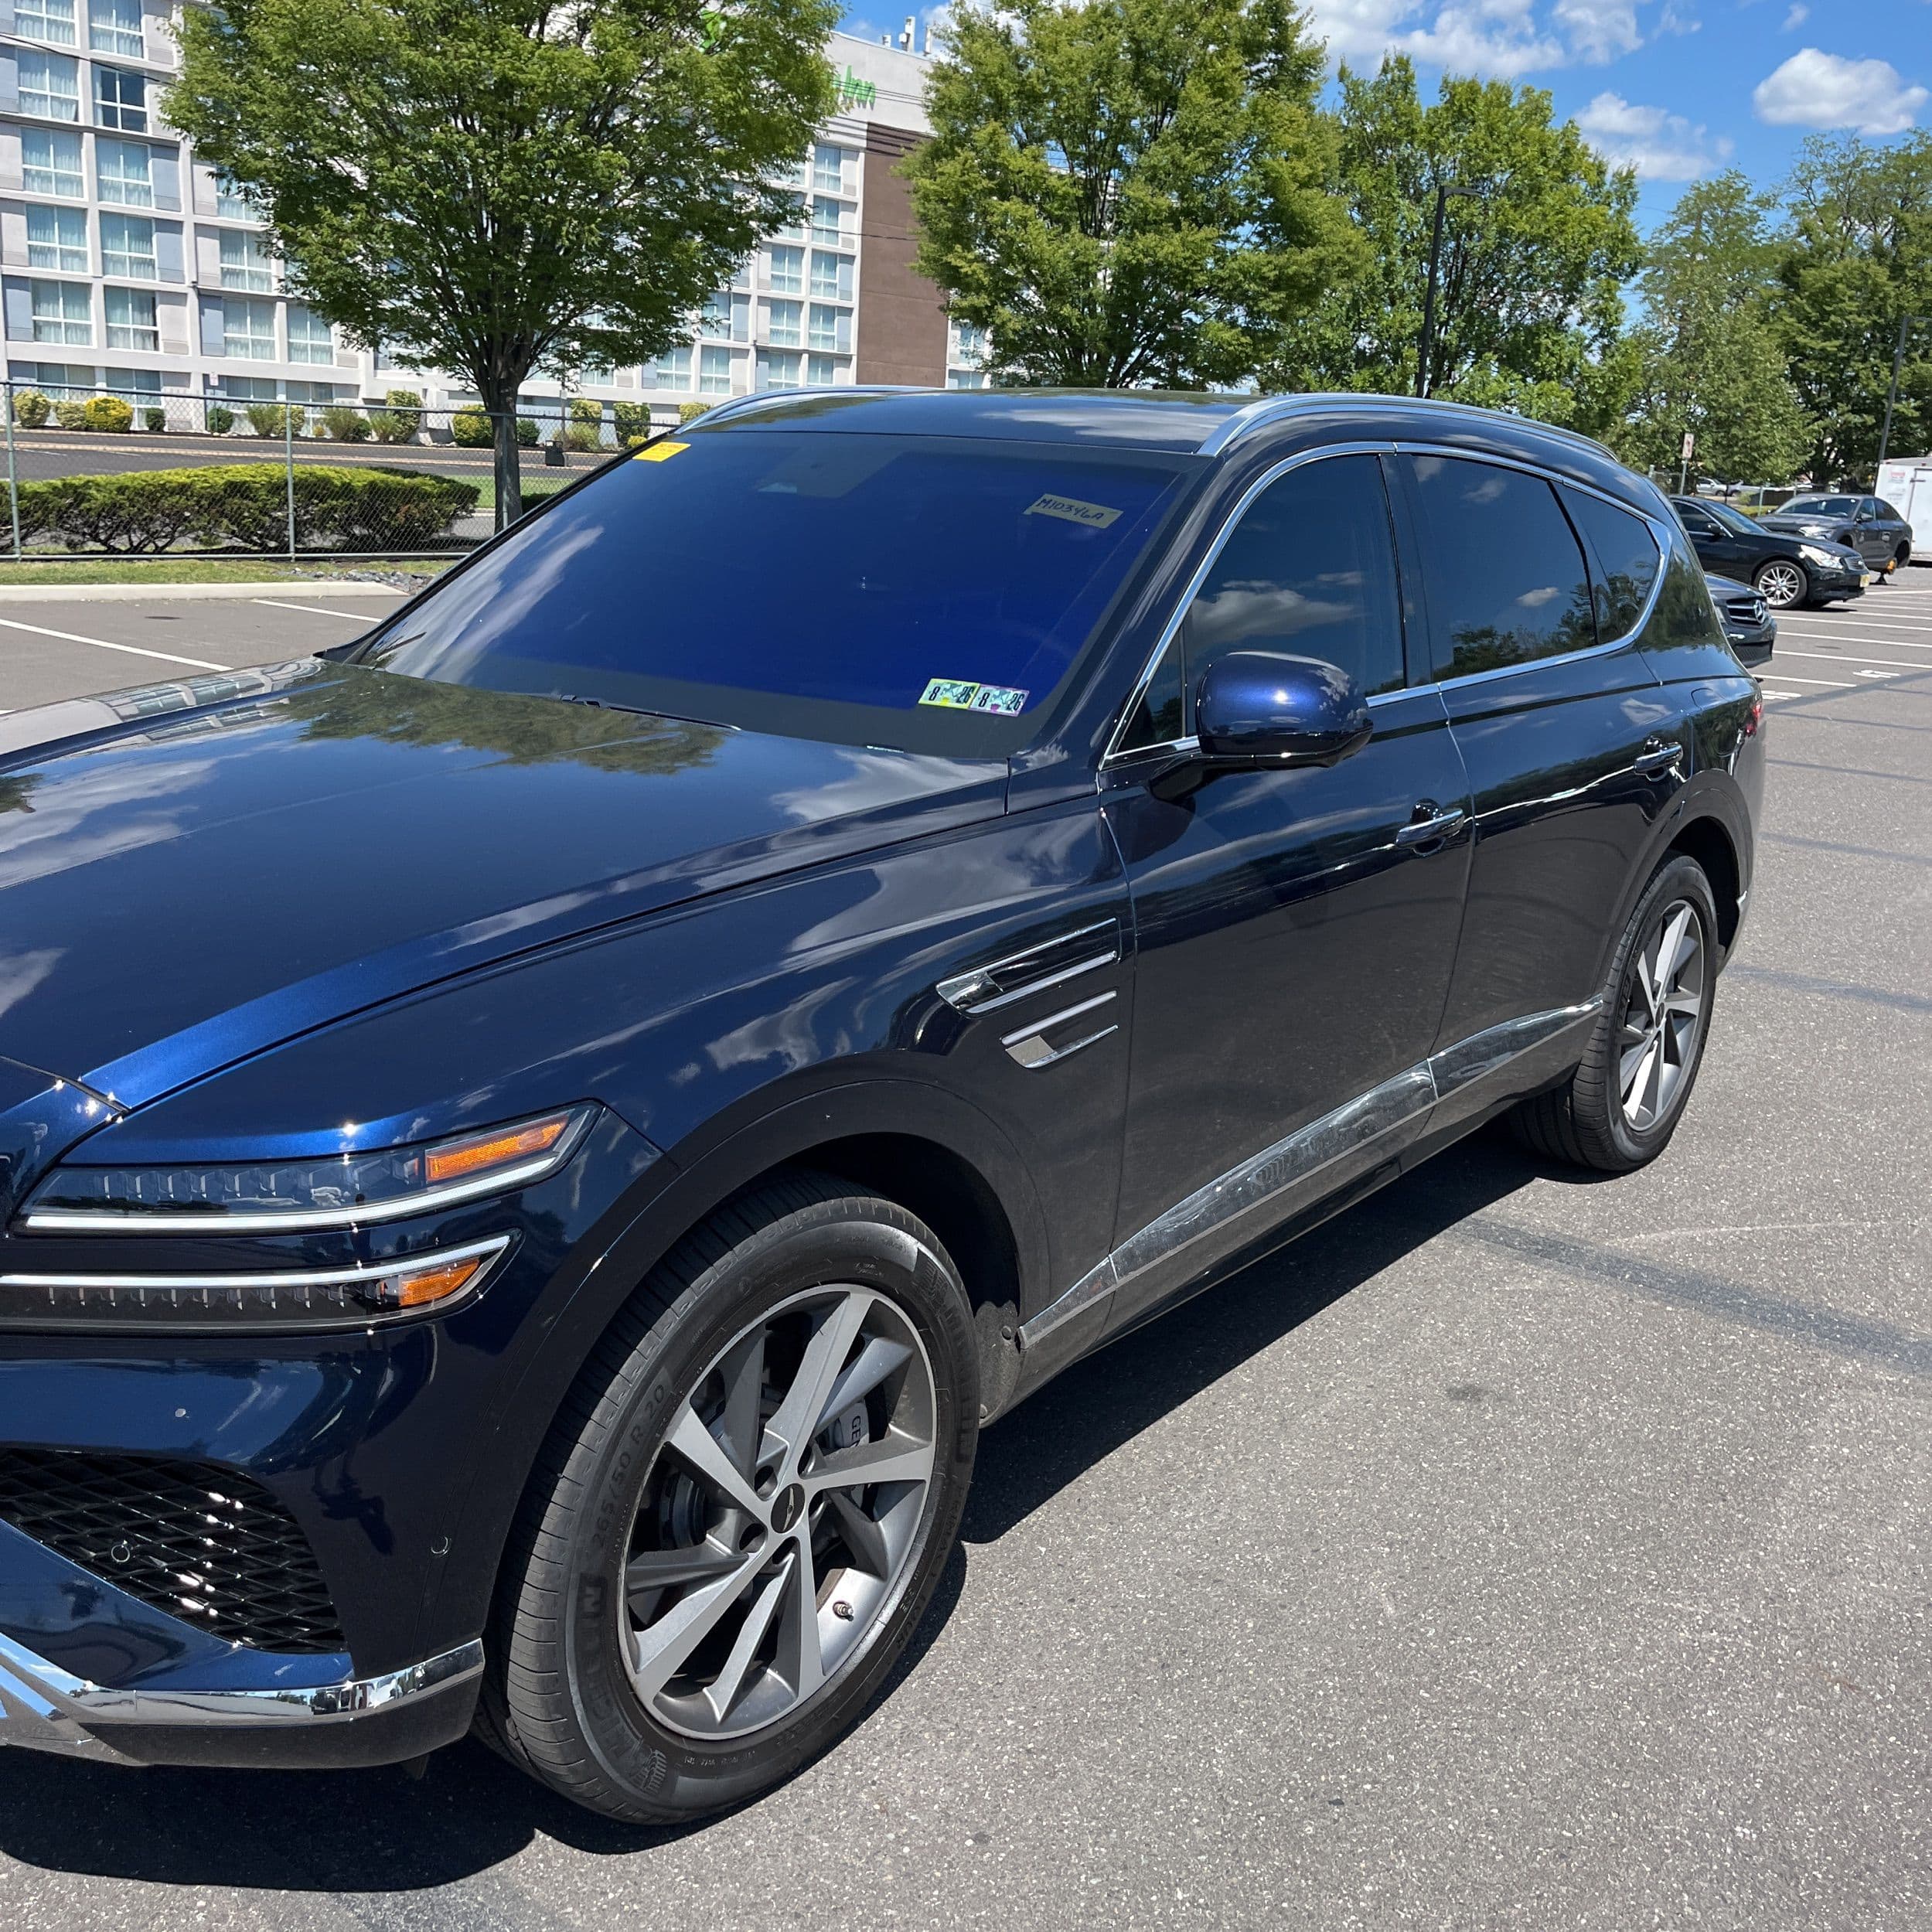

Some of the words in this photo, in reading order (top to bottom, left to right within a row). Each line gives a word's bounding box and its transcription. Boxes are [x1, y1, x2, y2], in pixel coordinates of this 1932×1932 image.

[844, 65, 876, 104] Inn
[929, 687, 941, 701] 8
[957, 686, 974, 704] 26
[979, 692, 990, 707] 8
[1007, 693, 1025, 710] 26
[592, 1452, 632, 1547] 265/50
[630, 1425, 644, 1444] R
[644, 1384, 666, 1420] 20
